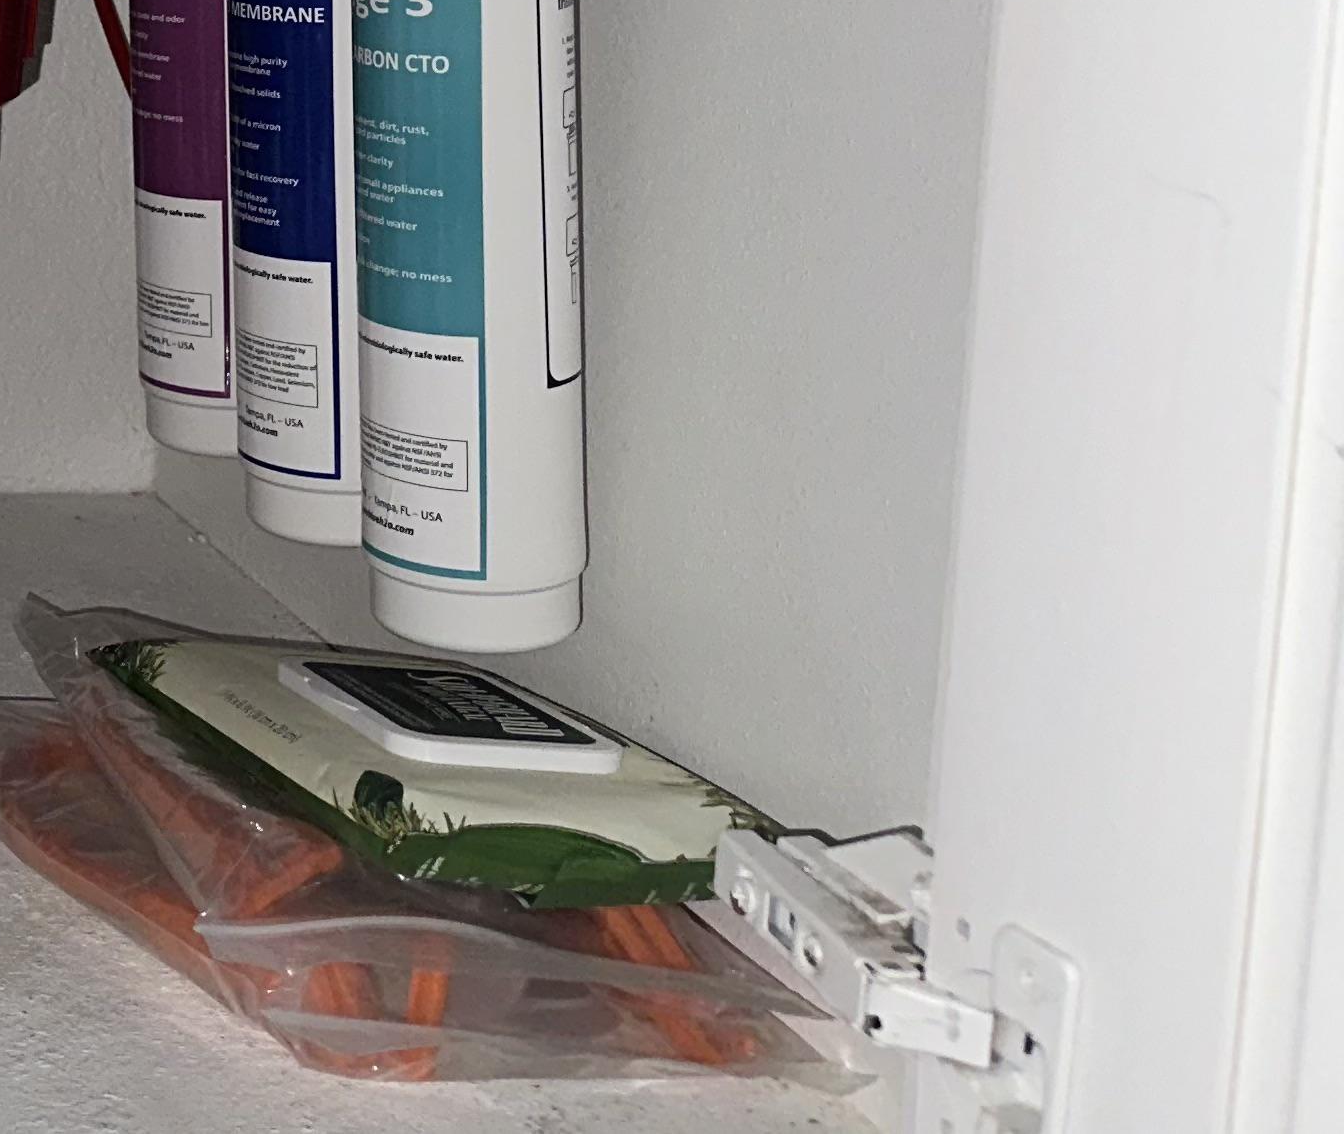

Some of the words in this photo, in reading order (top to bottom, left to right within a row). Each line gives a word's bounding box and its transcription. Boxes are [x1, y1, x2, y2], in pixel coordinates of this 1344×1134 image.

[231, 0, 325, 24] MEMBRANE
[405, 54, 450, 74] CTO
[402, 125, 430, 136] rust,
[366, 131, 407, 145] particles
[260, 174, 299, 187] recovery
[382, 181, 444, 197] appliances
[386, 219, 418, 231] water
[401, 270, 417, 280] no
[419, 272, 453, 283] mess
[177, 340, 195, 351] USA
[414, 350, 433, 360] safe
[434, 353, 464, 363] water.
[284, 417, 304, 428] USA
[421, 510, 443, 523] USA
